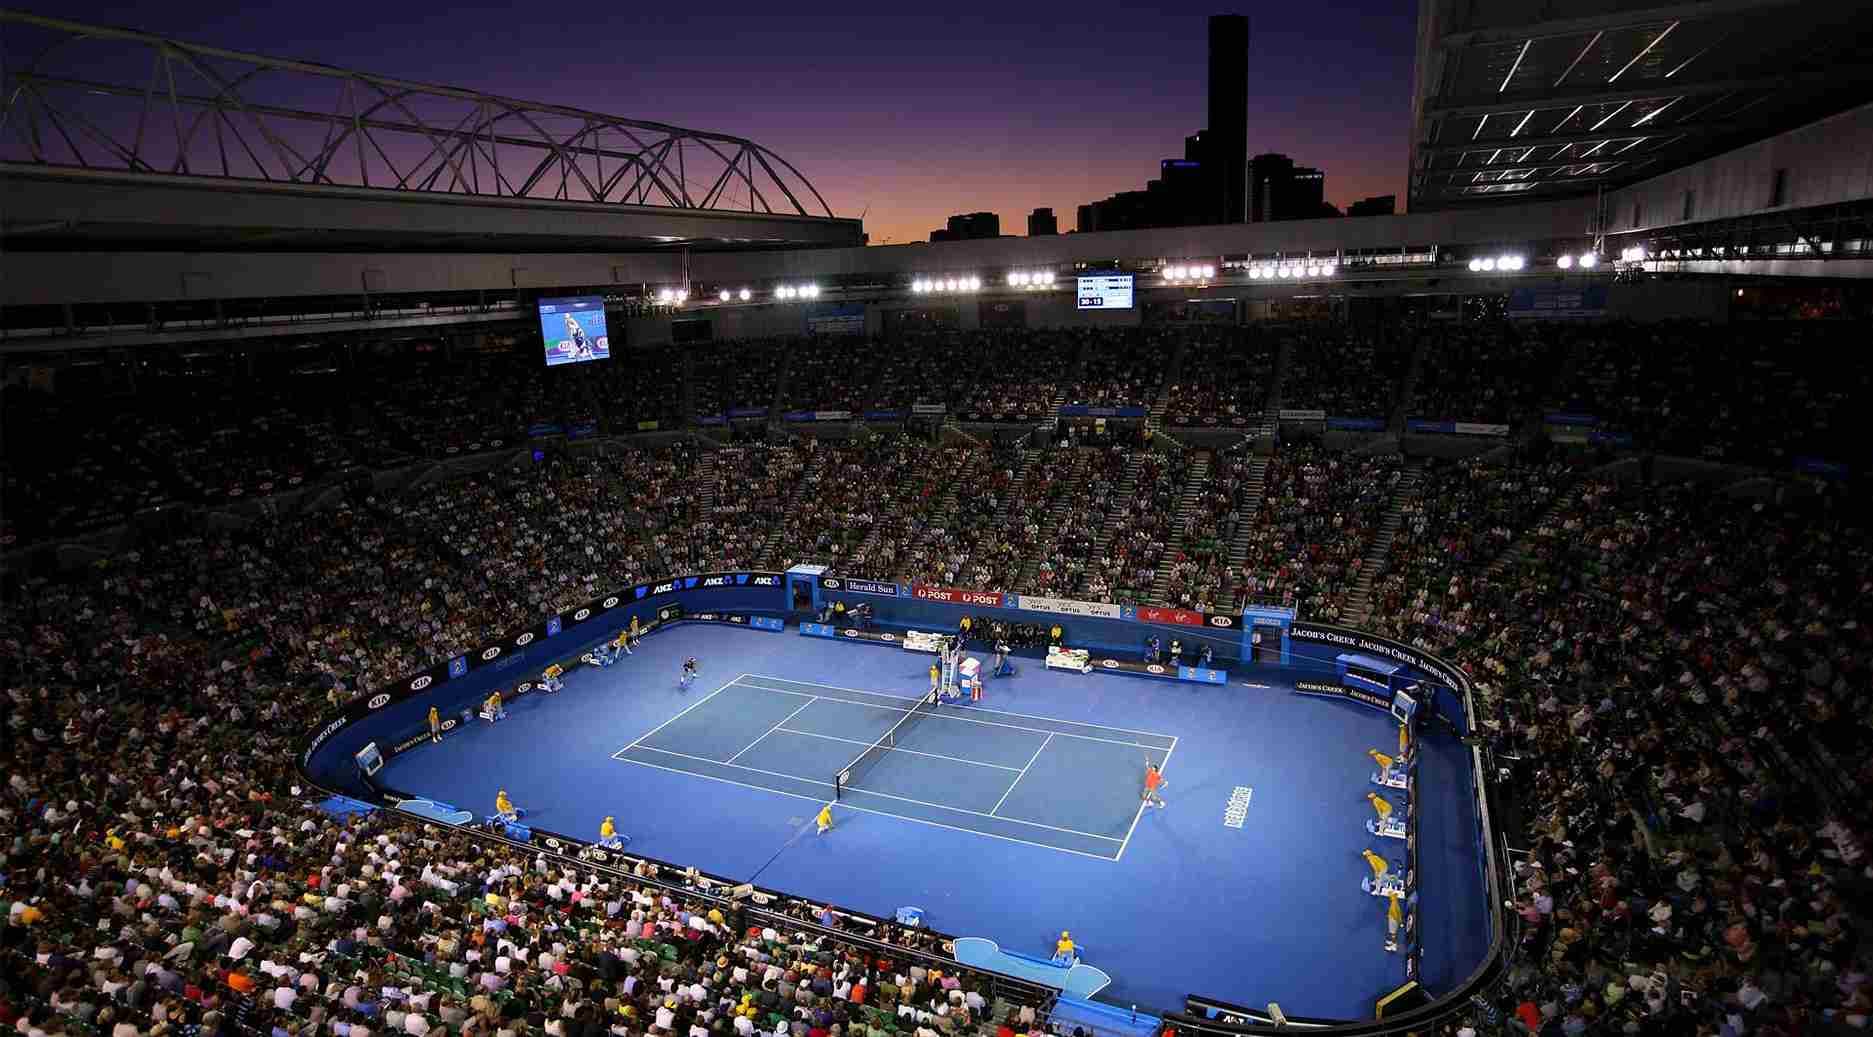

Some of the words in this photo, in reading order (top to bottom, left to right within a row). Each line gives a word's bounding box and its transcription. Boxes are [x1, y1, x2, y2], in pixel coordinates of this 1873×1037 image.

[849, 582, 876, 592] Herald
[879, 584, 894, 594] Sun
[927, 591, 952, 600] POST
[972, 595, 998, 604] POST
[1212, 617, 1231, 627] KIA
[518, 634, 533, 645] KIA
[1291, 627, 1325, 639] JACOB'S
[1326, 632, 1356, 645] CREEK
[483, 648, 500, 660] KIA
[1359, 640, 1391, 655] JACOB'S
[1391, 648, 1417, 664] CREEK
[412, 677, 431, 690] KIA
[370, 695, 390, 708] KIA
